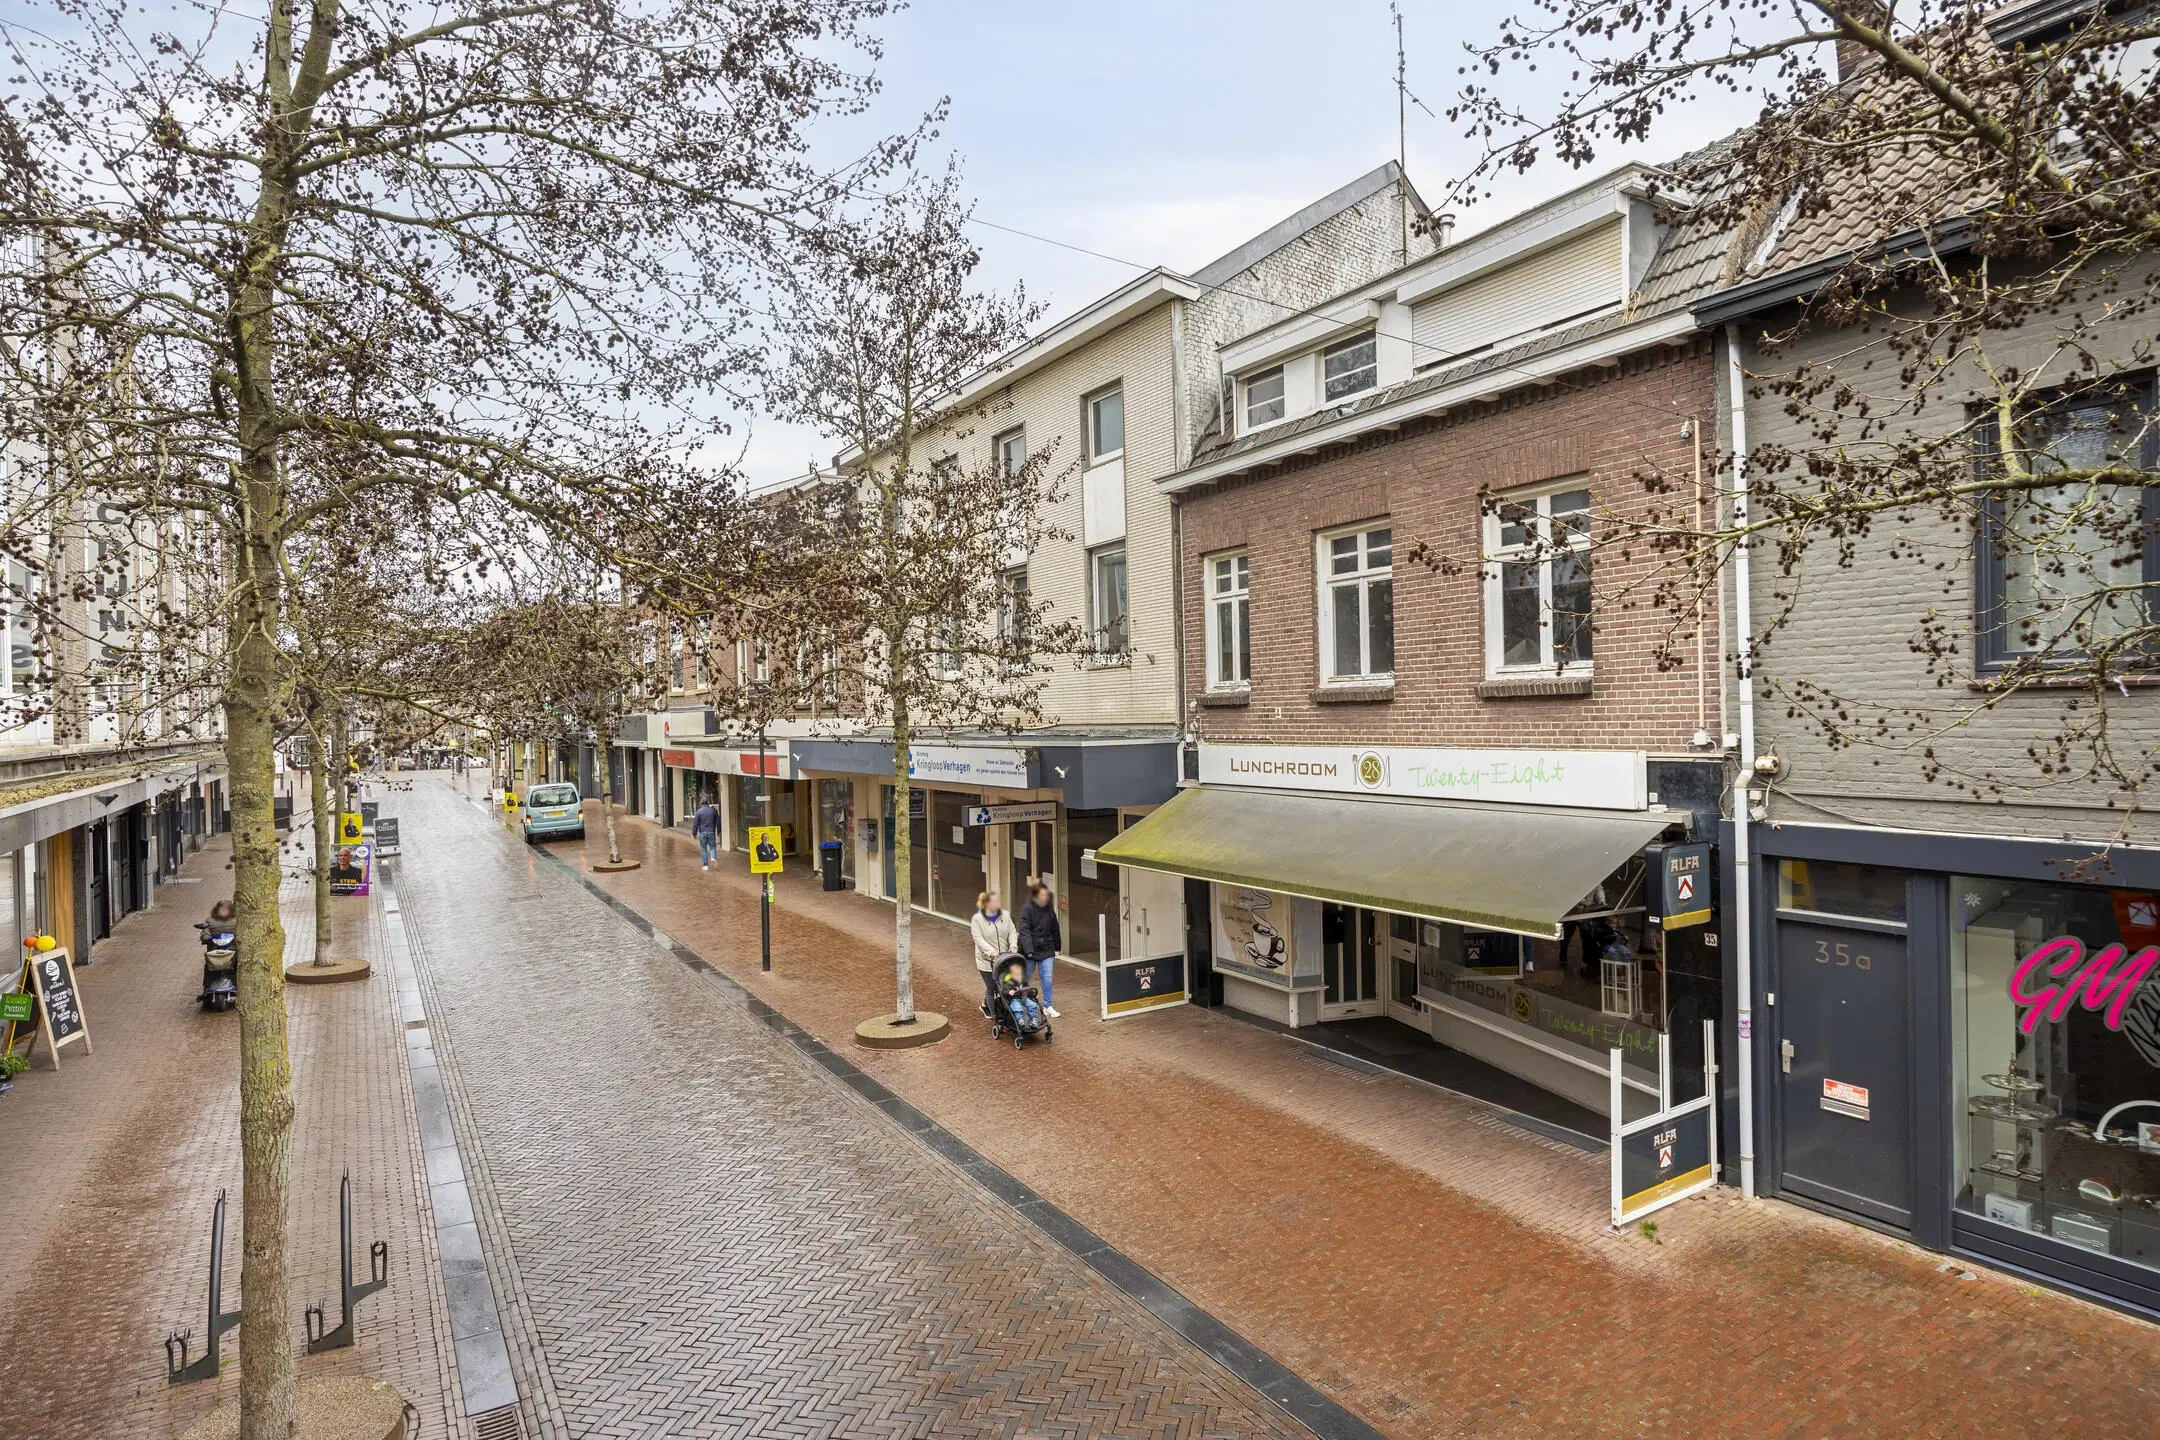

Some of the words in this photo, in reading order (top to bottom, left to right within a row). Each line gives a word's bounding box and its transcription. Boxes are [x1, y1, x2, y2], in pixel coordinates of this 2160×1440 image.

[1363, 760, 1380, 780] 28
[1408, 757, 1565, 793] Twenty-Eight
[1670, 855, 1700, 872] ALFA
[1706, 934, 1716, 946] 35
[1815, 940, 1871, 970] 35a
[1134, 966, 1156, 977] ALFA
[2009, 937, 2160, 1034] GM
[1653, 1128, 1677, 1147] ALFA
